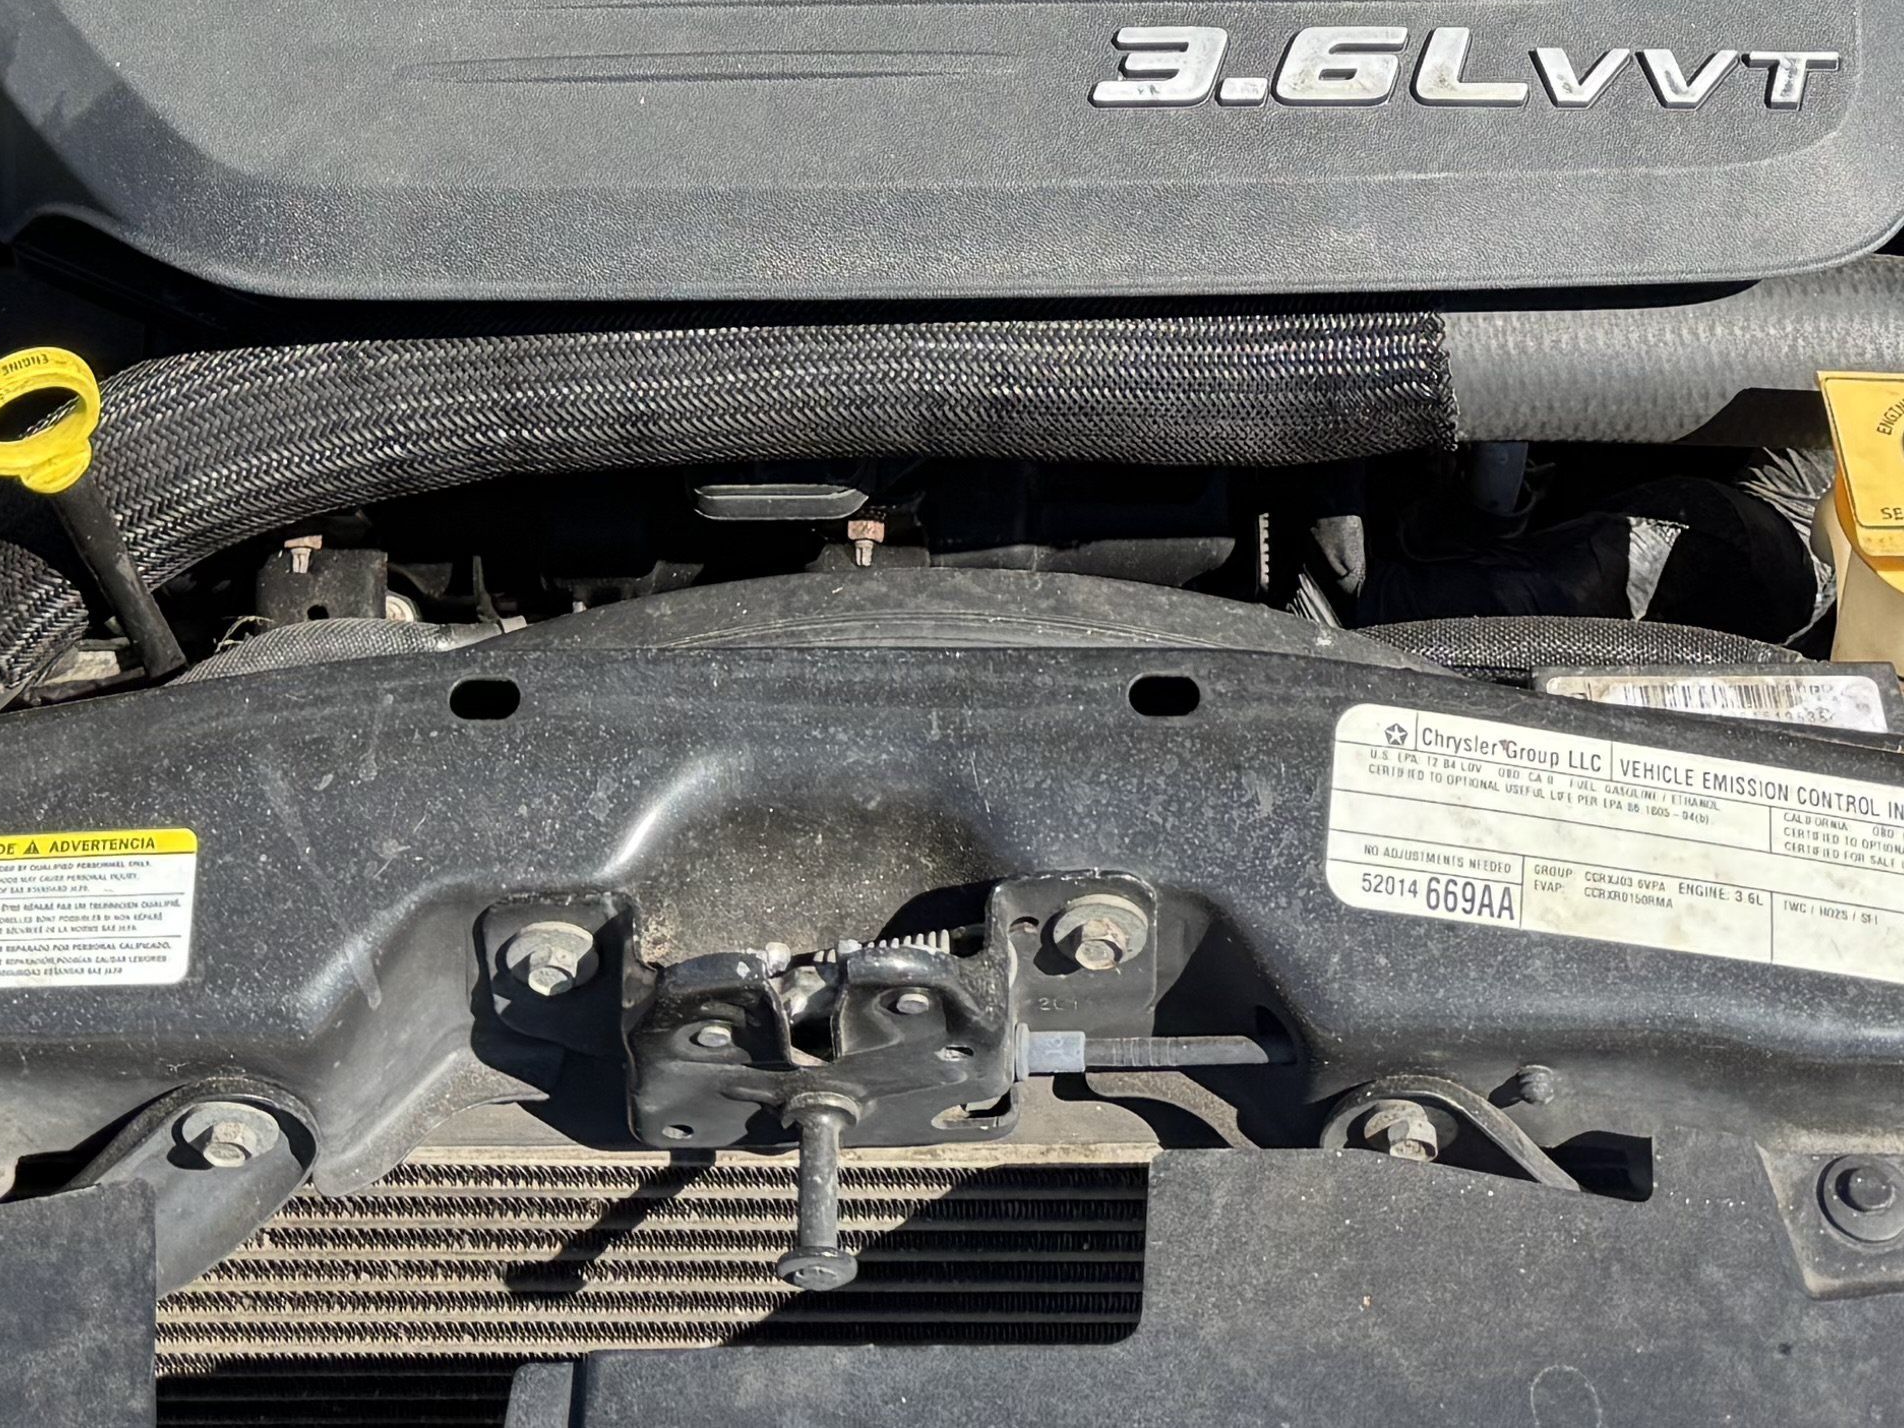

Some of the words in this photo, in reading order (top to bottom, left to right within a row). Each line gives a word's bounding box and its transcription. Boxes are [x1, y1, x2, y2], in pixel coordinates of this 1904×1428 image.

[1089, 26, 1529, 110] 3.6L
[1529, 46, 1842, 111] VVT
[1421, 725, 1497, 758] Chrysler
[1505, 739, 1560, 767] Group
[1568, 749, 1601, 774] LLC
[1620, 758, 1694, 787] VEHICLE
[1702, 771, 1789, 802] EMISSION
[1797, 786, 1879, 817] CONTROL
[48, 836, 156, 854] ADVERTENCIA
[1364, 842, 1379, 856] NO
[1383, 844, 1464, 869] ADJUSTMENTS
[1468, 856, 1511, 874] NEEDED
[1361, 871, 1418, 899] 52014
[1425, 875, 1516, 922] 669AA
